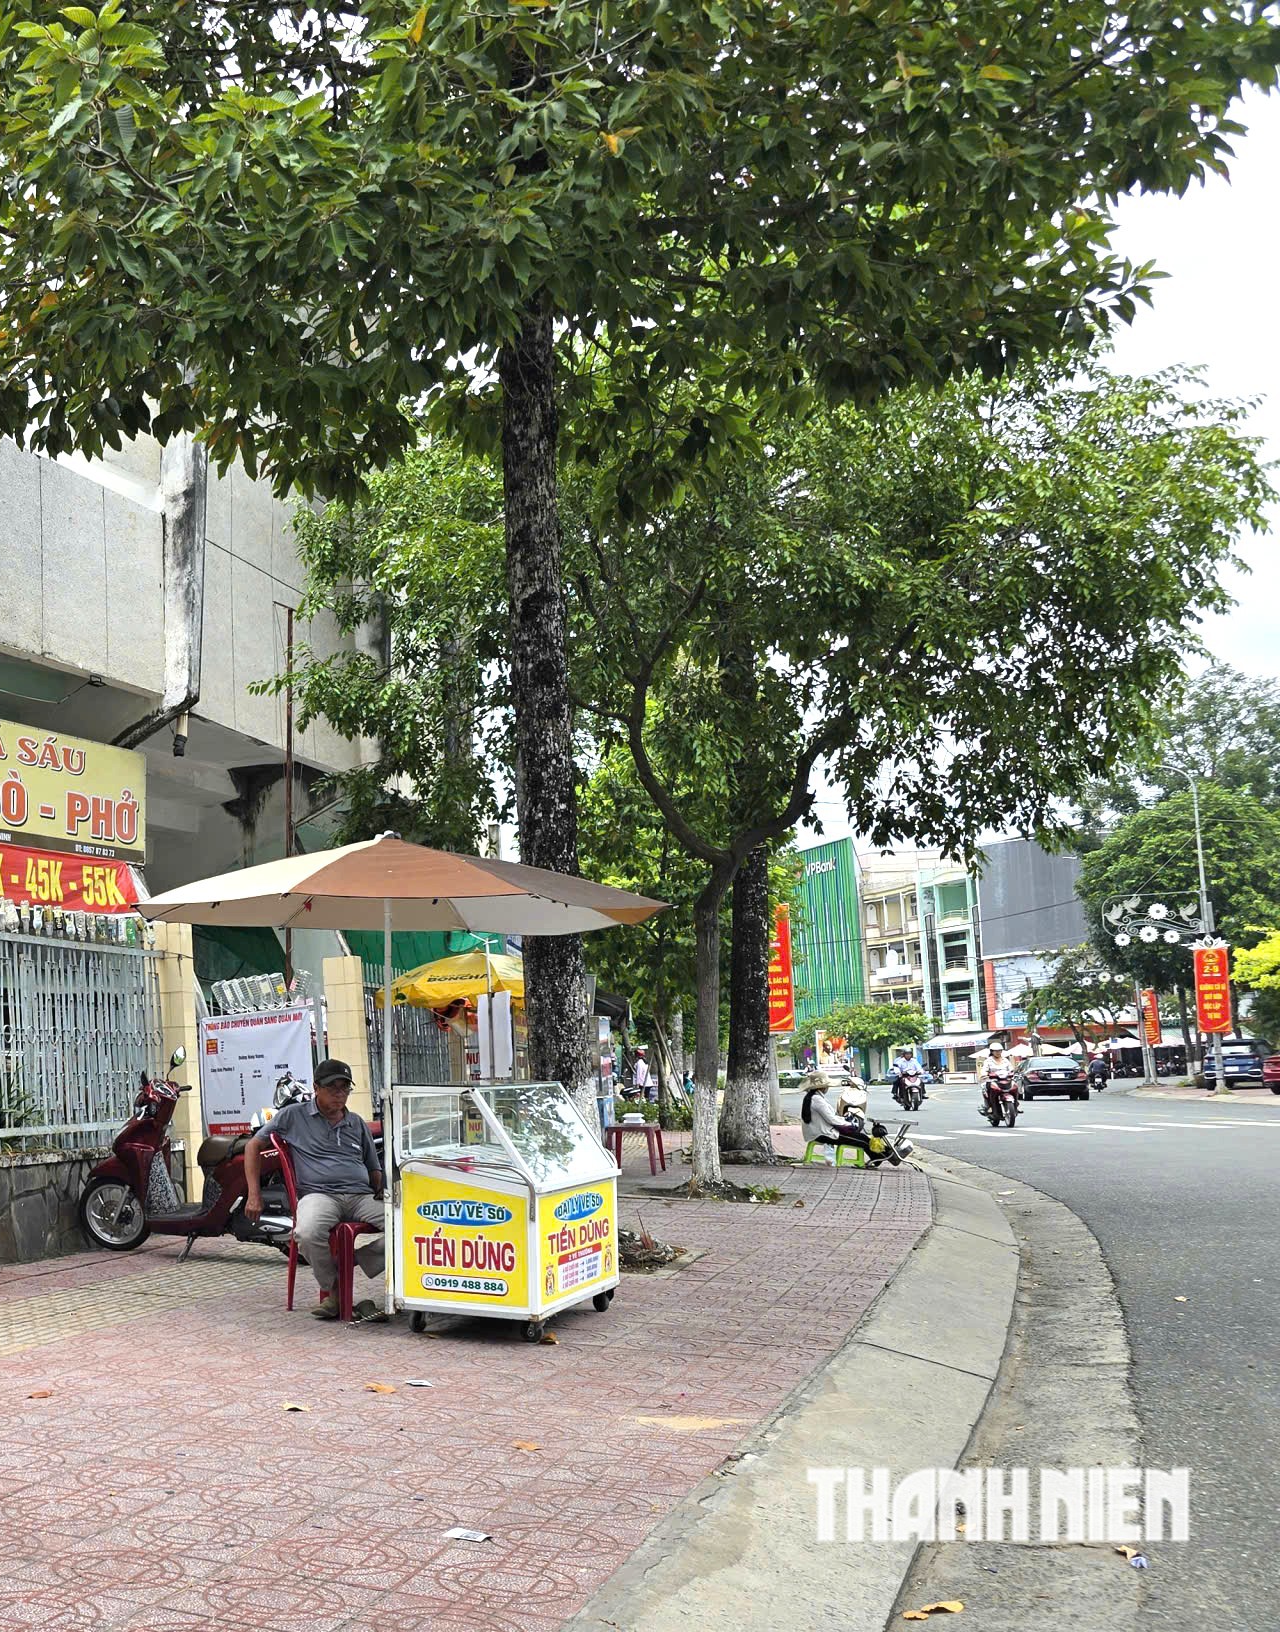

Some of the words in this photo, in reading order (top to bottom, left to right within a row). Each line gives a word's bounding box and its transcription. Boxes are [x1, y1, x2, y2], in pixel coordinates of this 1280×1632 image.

[16, 736, 87, 775] SÁU
[66, 789, 138, 844] PHỞ
[25, 857, 64, 902] 45K
[82, 865, 127, 906] 55K
[805, 857, 836, 876] VPBank
[264, 1015, 277, 1025] SANG
[422, 1204, 444, 1219] ĐẠI
[448, 1201, 462, 1217] LÝ
[466, 1203, 483, 1218] VÉ
[487, 1206, 506, 1220] SỐ
[558, 1199, 570, 1218] ĐẠI
[572, 1193, 579, 1214] LÝ
[582, 1192, 590, 1210] VÉ
[591, 1192, 600, 1207] SỐ
[414, 1227, 456, 1267] TIẾN
[461, 1234, 515, 1272] DŨNG
[548, 1223, 576, 1255] TIẾN
[579, 1217, 609, 1246] DŨNG
[434, 1278, 459, 1288] 0919
[461, 1280, 481, 1290] 488
[483, 1282, 504, 1291] 884
